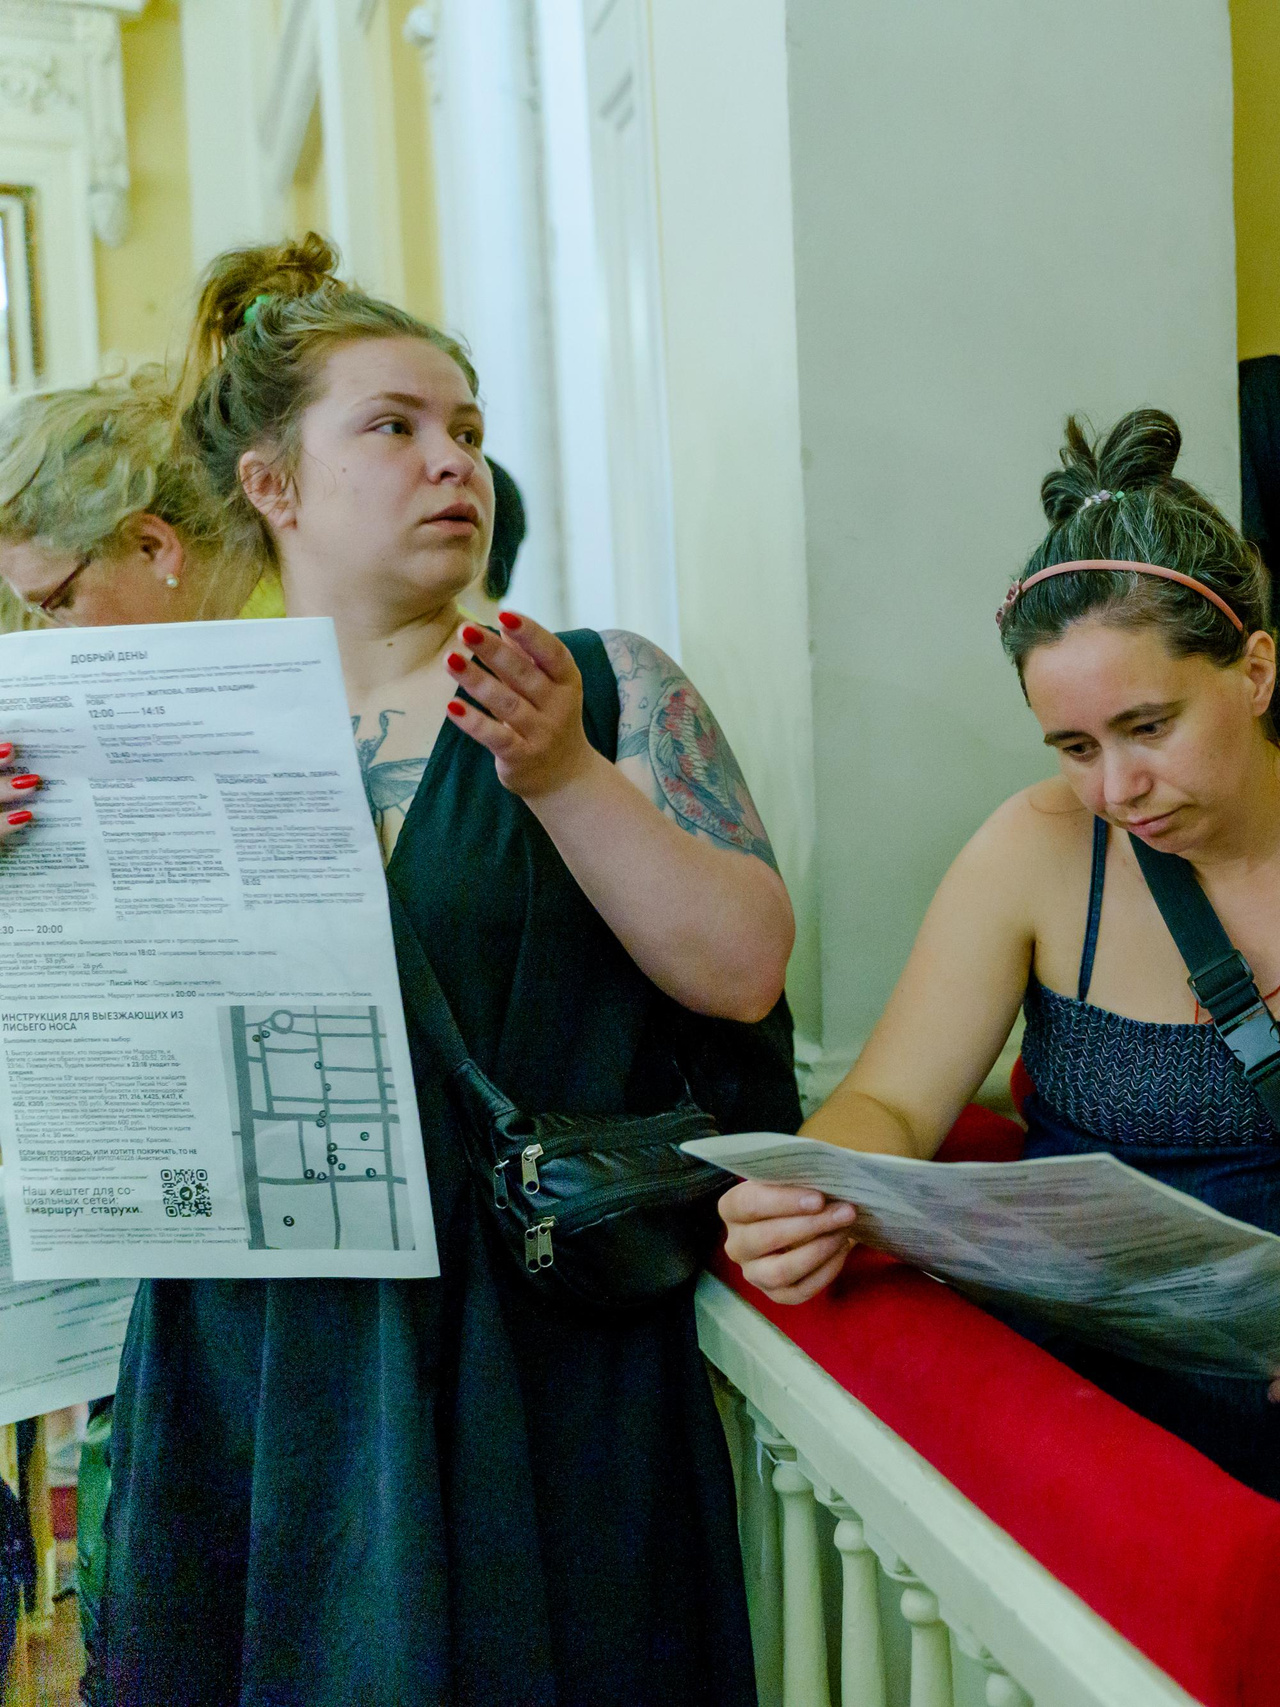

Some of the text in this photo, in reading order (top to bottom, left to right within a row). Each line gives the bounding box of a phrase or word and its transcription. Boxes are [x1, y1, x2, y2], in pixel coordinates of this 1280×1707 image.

[71, 651, 115, 664] ДОБРЫЙ
[88, 706, 165, 718] 12:00 14:15
[36, 925, 63, 934] 20:00
[1, 1011, 183, 1022] ИНСТРУКЦИЯ ДЛЯ ВЫЕЗЖАЮЩИХ ИЗ
[3, 1022, 77, 1032] ЛИСЬЕГО НОСА
[22, 1186, 135, 1197] Наш хештег для со-
[24, 1196, 118, 1206] циальных сетей:
